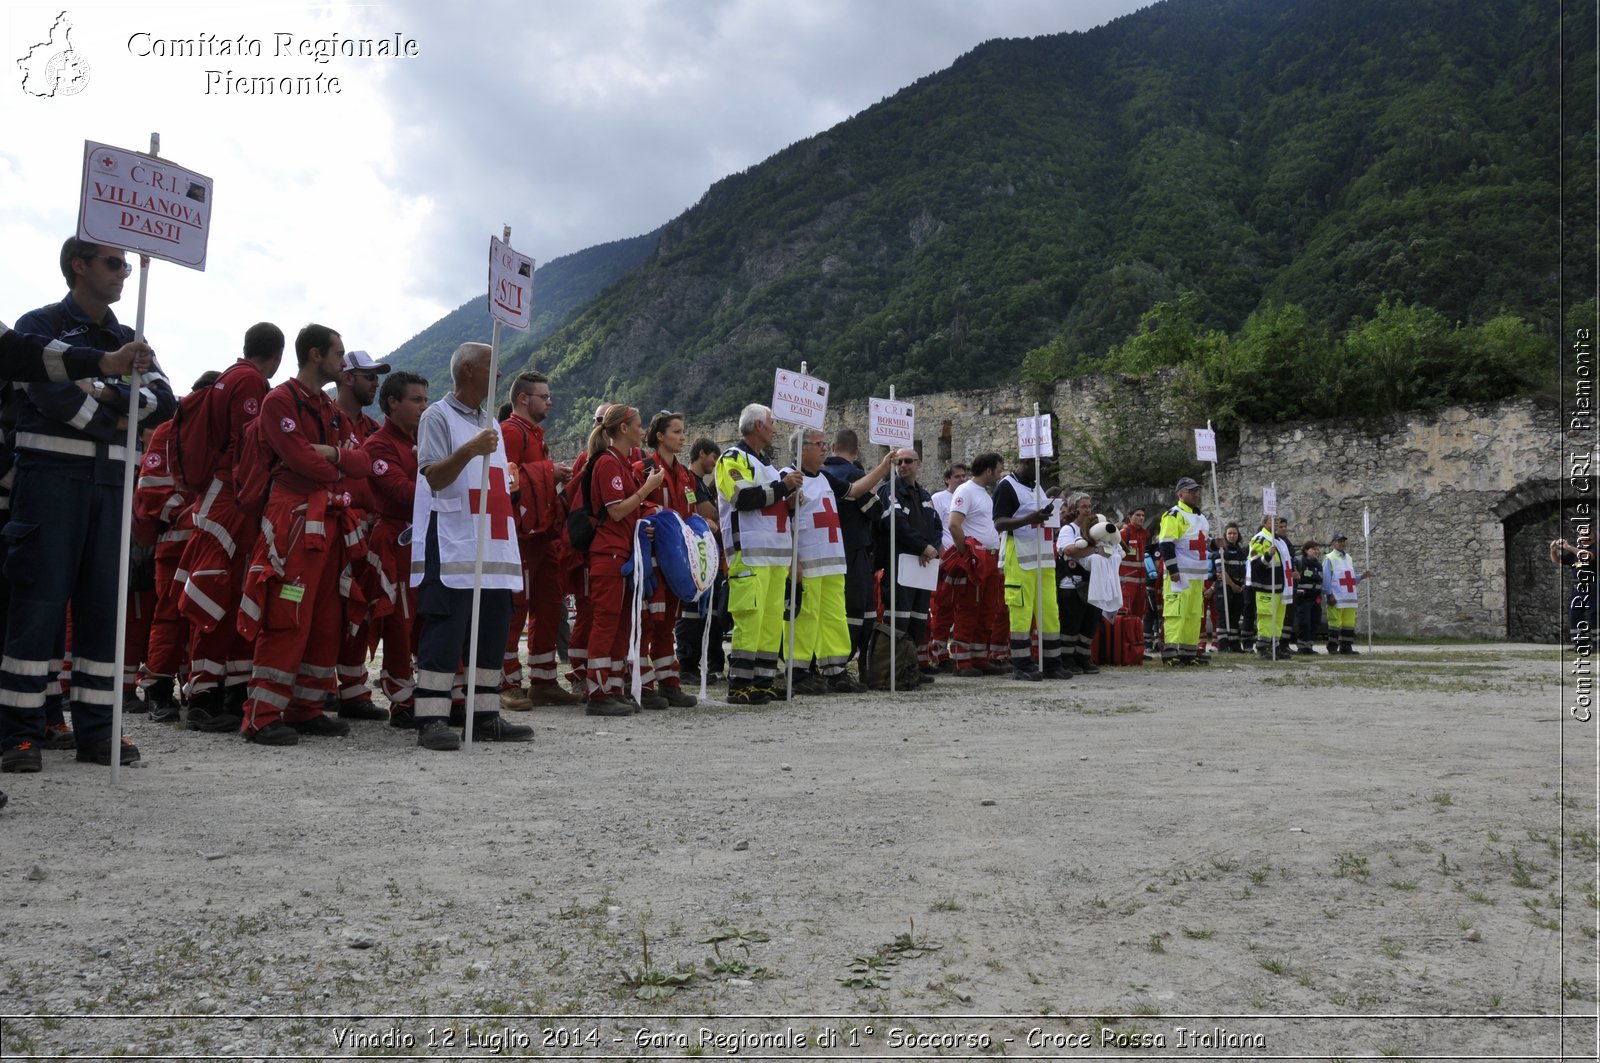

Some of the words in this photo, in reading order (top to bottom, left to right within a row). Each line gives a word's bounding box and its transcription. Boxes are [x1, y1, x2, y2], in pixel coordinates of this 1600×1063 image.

[130, 166, 181, 195] C.R.I.
[95, 182, 202, 226] VILLANOVA
[119, 212, 182, 240] D'ASTI
[793, 378, 815, 393] C.R.I.
[777, 392, 793, 402] SAN
[794, 394, 824, 411] DAMIANO
[790, 404, 813, 417] D'ASTI
[885, 405, 905, 416] C.R.I.
[877, 416, 910, 428] BORMIDA
[875, 427, 911, 439] ASTIGIANA
